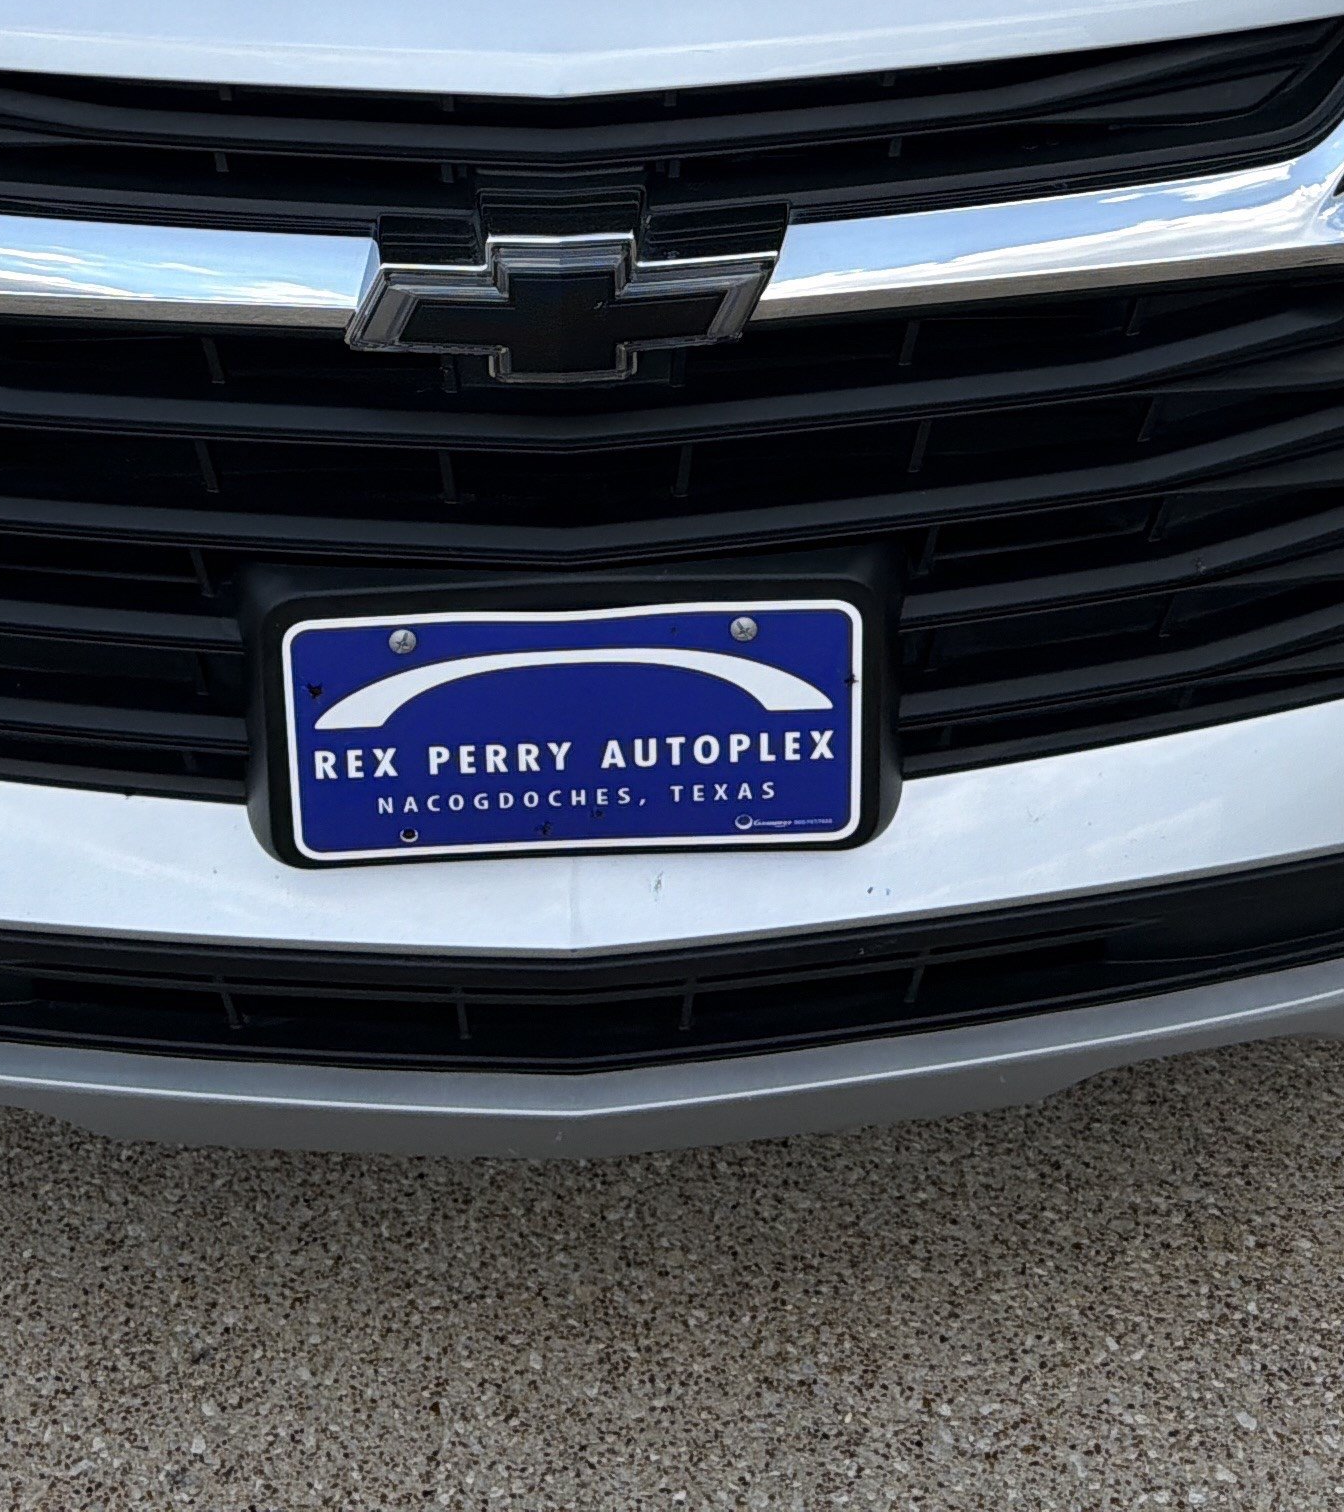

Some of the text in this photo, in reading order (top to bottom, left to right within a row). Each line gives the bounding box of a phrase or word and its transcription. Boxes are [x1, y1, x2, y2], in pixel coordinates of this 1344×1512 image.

[314, 730, 834, 779] REX PERRY AUTOPLEX
[378, 781, 775, 814] NACOGDOCHES, TEXAS
